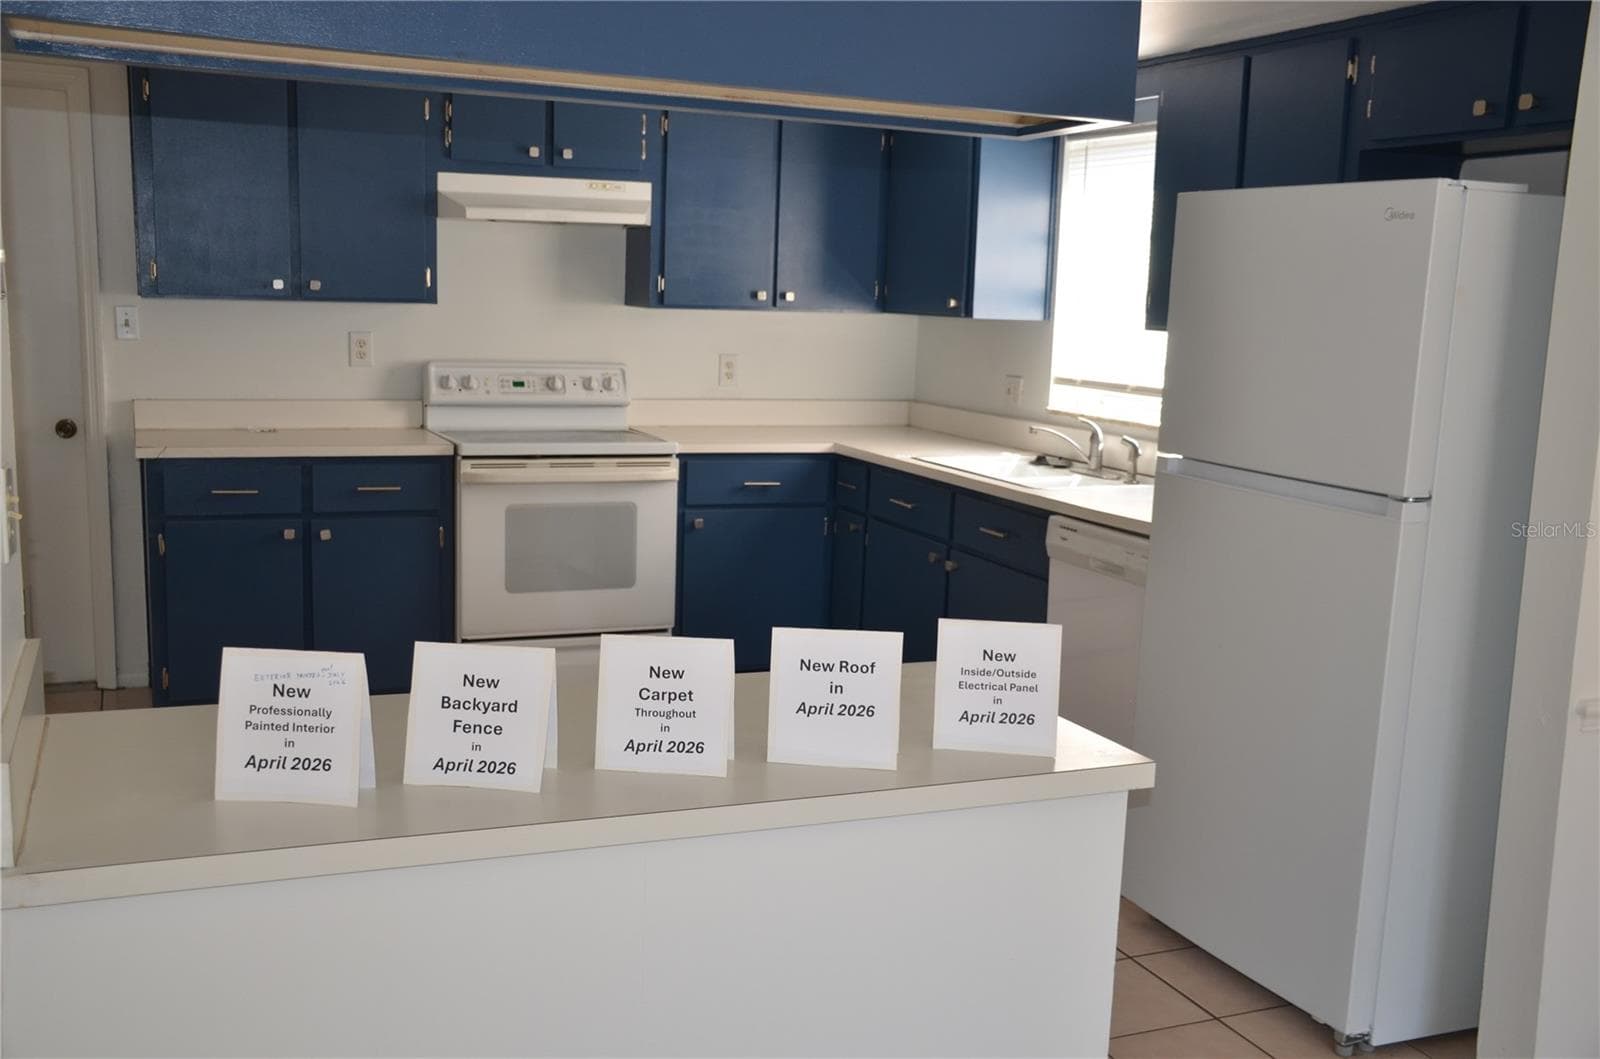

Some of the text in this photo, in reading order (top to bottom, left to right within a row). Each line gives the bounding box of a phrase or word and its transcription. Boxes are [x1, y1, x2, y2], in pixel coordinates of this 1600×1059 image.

[982, 649, 1017, 663] New
[649, 665, 685, 680] New
[799, 658, 876, 674] New Roof
[960, 667, 1037, 679] Inside/Outside
[462, 673, 500, 689] New
[829, 681, 844, 695] in
[958, 680, 1039, 693] Electrical Panel
[272, 683, 311, 699] New
[638, 687, 694, 705] Carpet
[441, 695, 518, 715] Backyard
[992, 695, 1003, 705] in
[248, 704, 333, 719] Professionally
[634, 707, 697, 720] Throughout
[795, 701, 876, 718] April 2026
[958, 710, 1036, 726] April 2026
[244, 720, 335, 734] Painted Interior
[452, 719, 503, 736] Fence
[660, 723, 671, 733] in
[284, 737, 295, 748] in
[471, 742, 482, 752] in
[623, 739, 705, 756] April 2026
[244, 754, 332, 772] April 2026
[432, 757, 517, 775] April 2026
